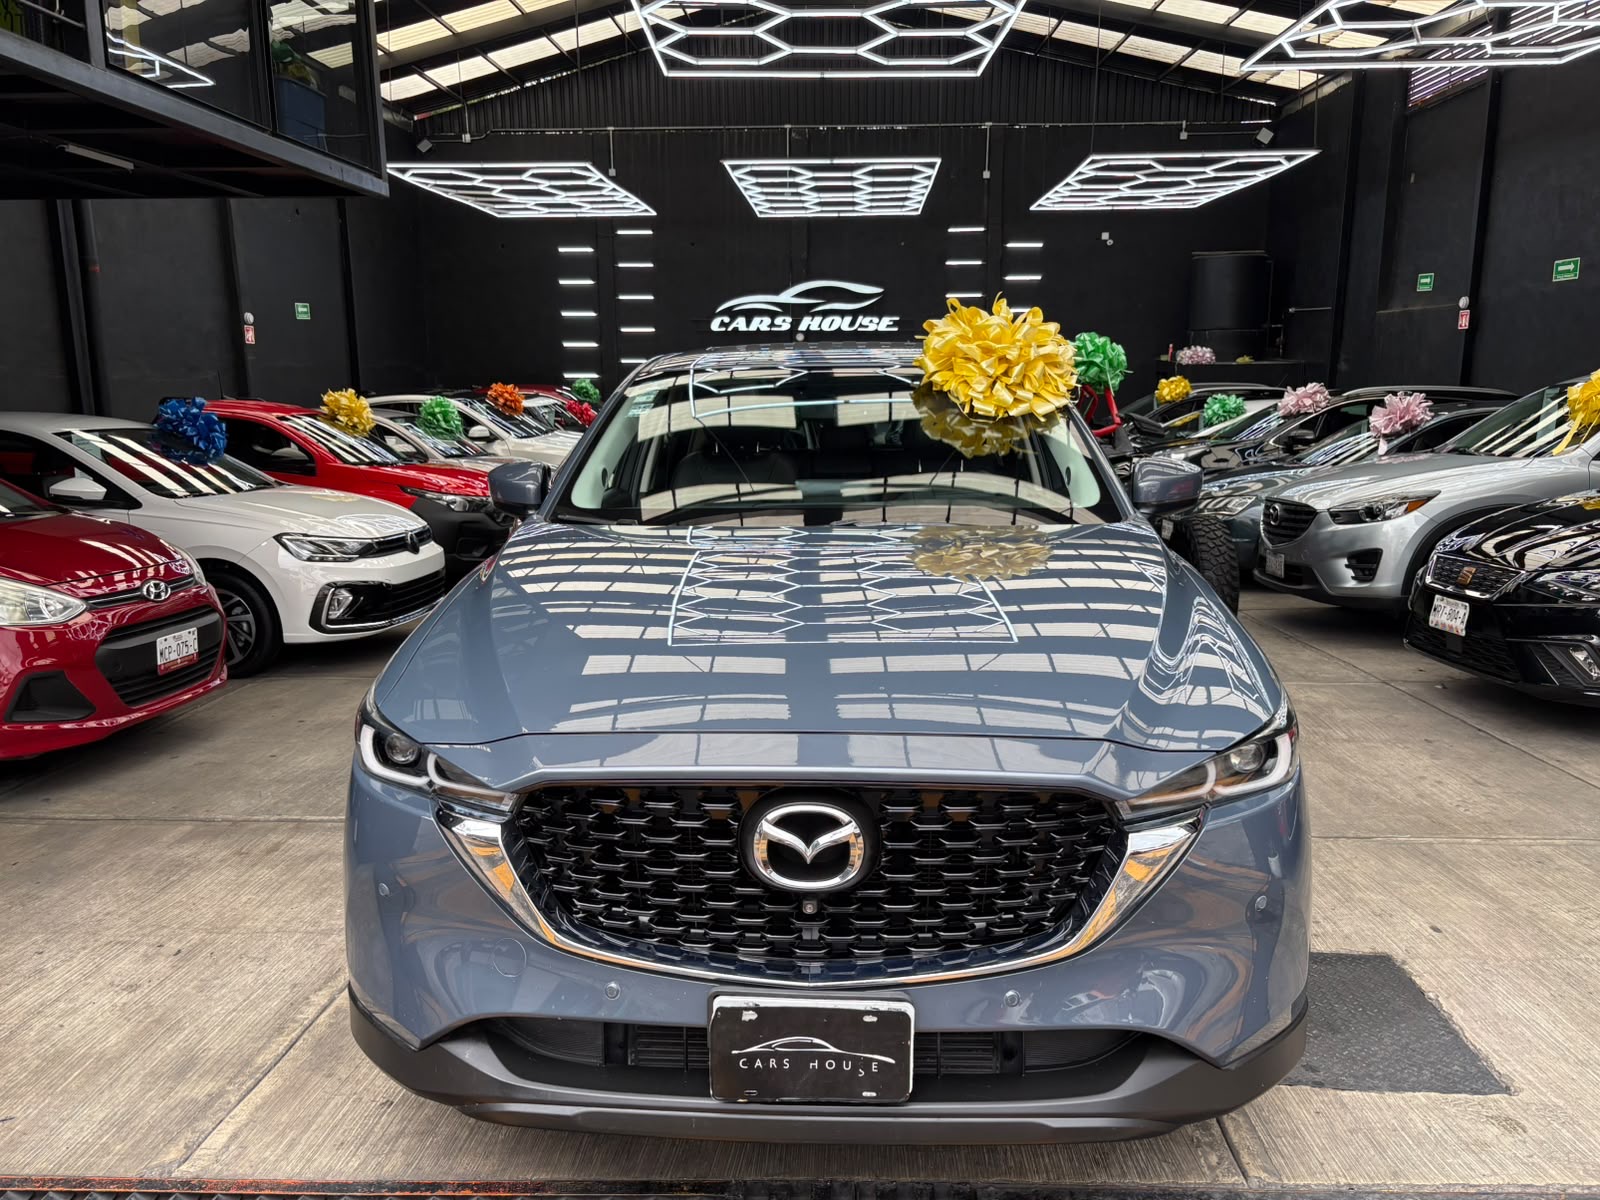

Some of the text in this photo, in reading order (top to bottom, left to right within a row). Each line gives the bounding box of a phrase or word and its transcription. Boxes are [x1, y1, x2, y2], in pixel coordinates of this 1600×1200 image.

[710, 316, 900, 331] CARS HOUSE
[739, 1058, 790, 1069] CARS
